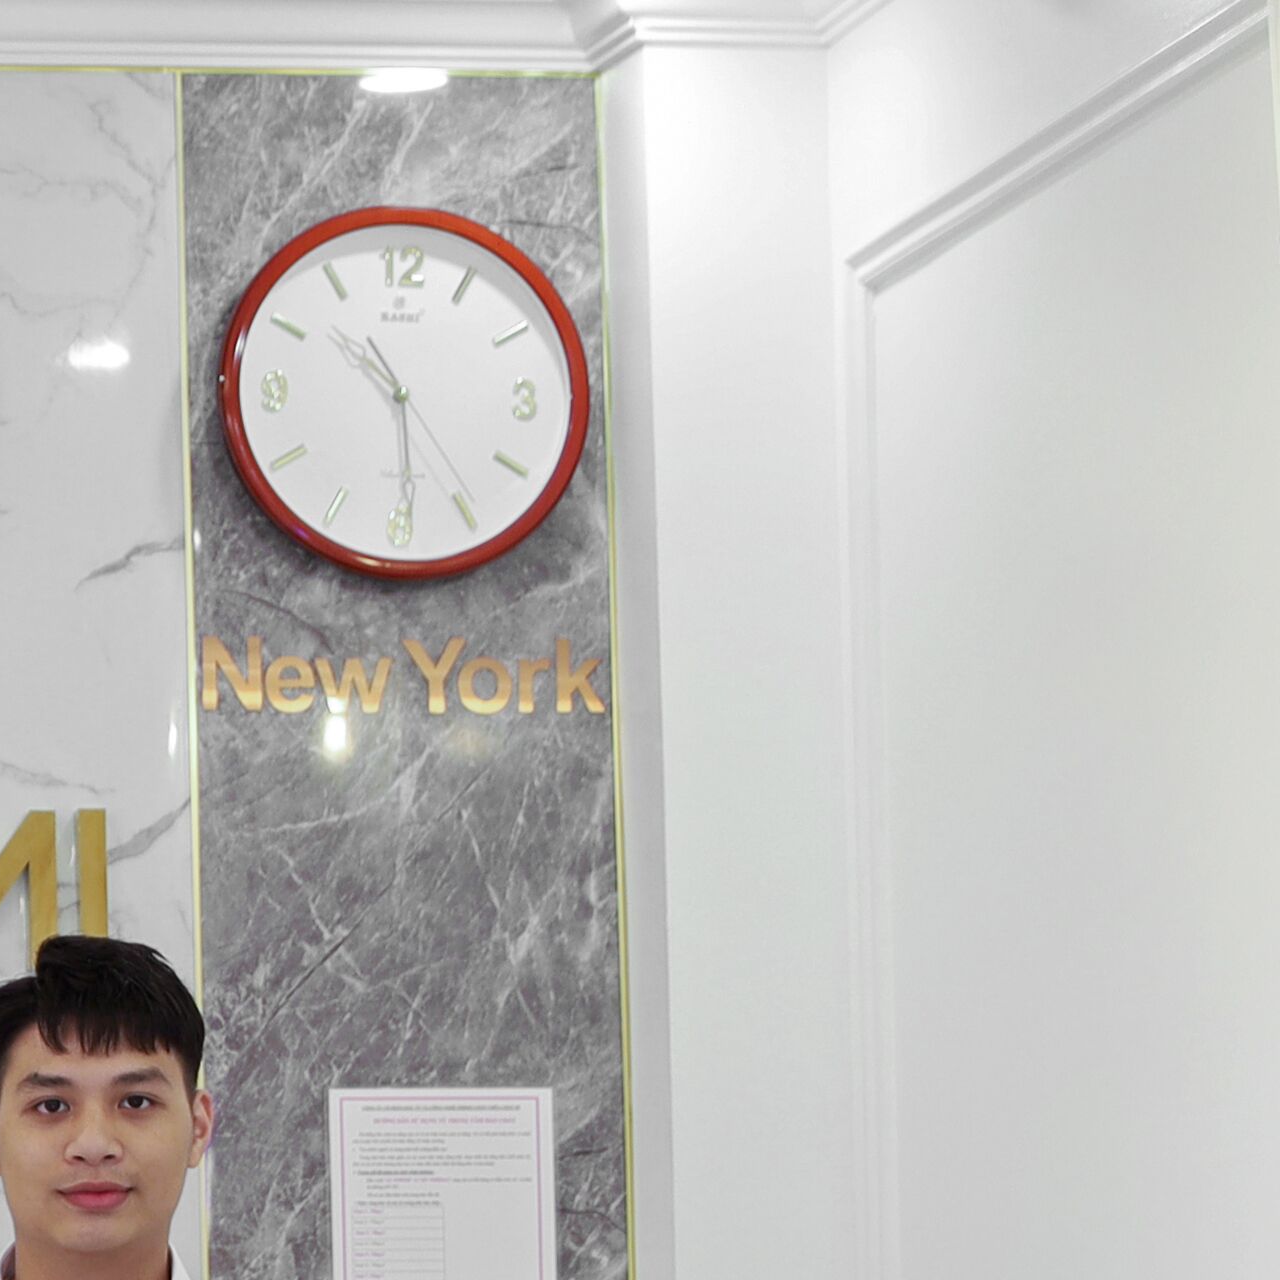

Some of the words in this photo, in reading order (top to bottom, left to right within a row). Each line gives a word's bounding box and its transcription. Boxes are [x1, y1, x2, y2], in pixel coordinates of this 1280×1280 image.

[380, 246, 424, 288] 12
[261, 369, 289, 412] 9
[512, 377, 537, 421] 3
[200, 635, 394, 716] New
[402, 636, 606, 716] York
